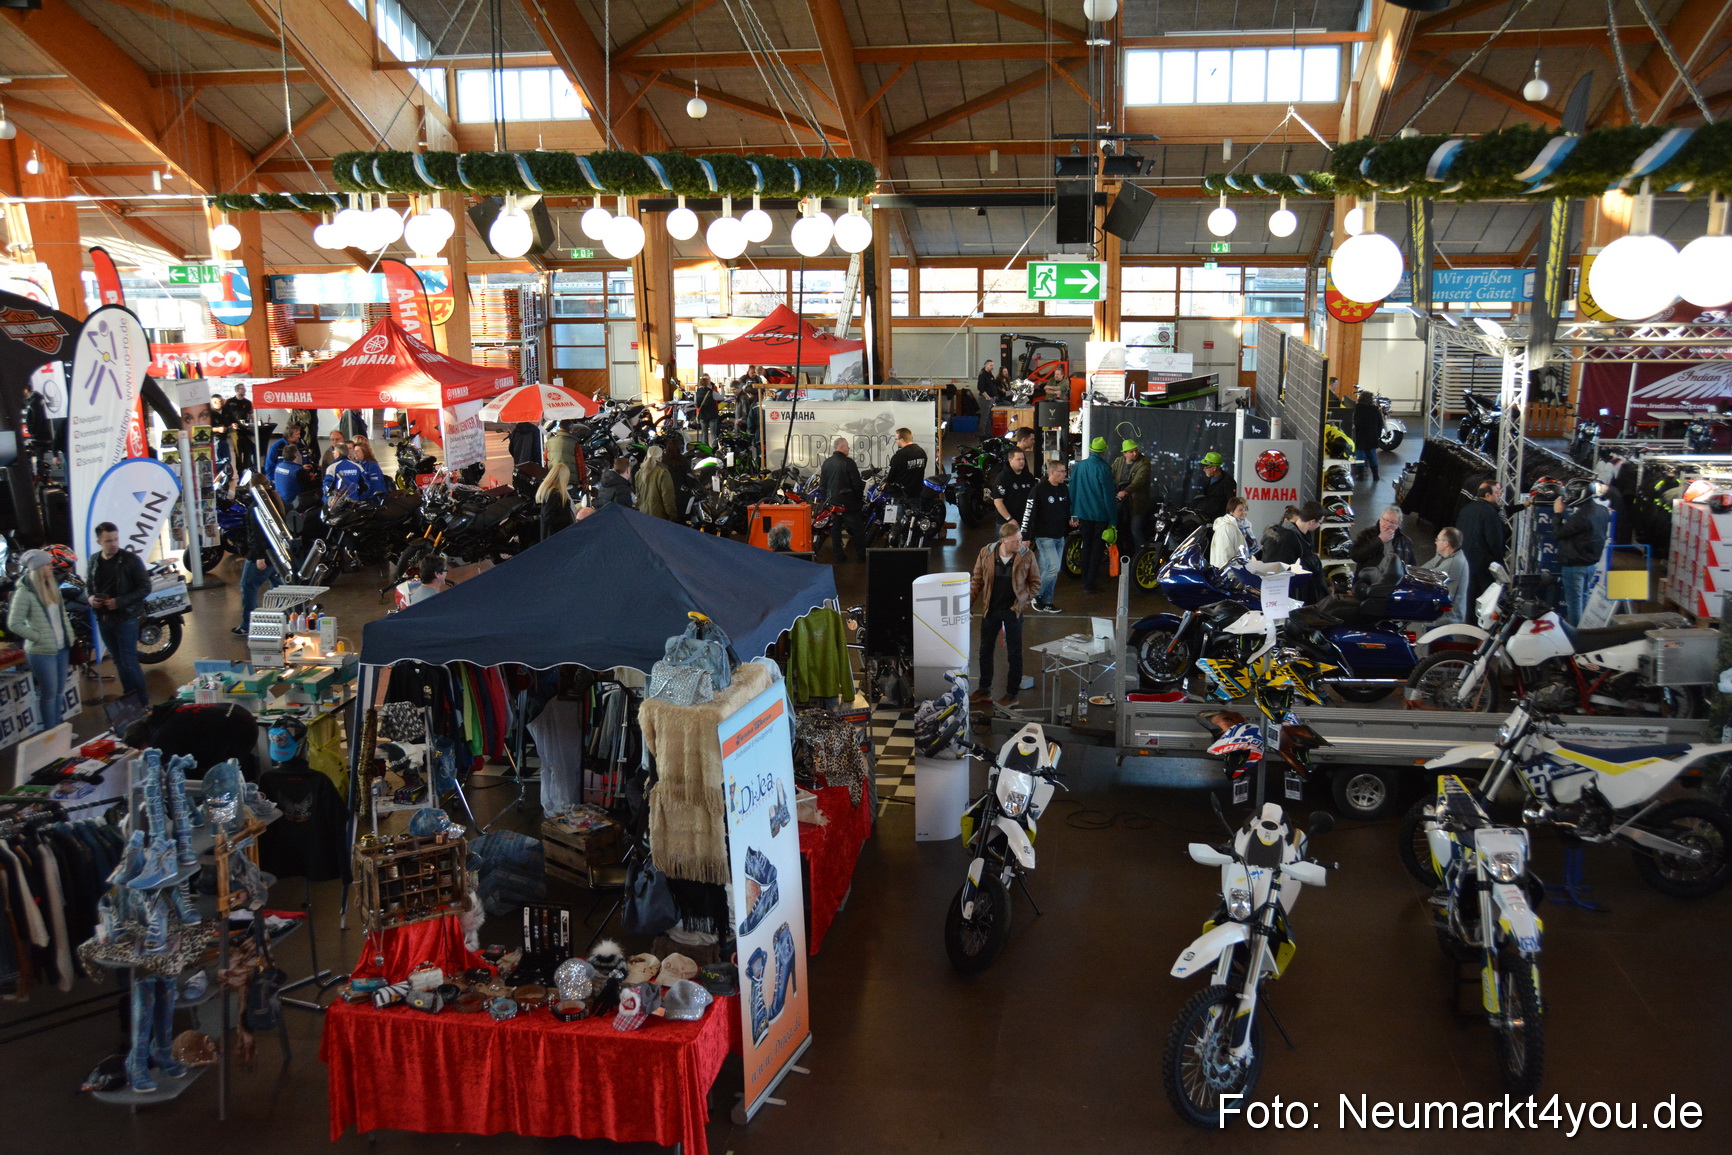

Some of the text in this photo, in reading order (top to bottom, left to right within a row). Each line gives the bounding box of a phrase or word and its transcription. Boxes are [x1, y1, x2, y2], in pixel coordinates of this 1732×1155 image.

[1438, 272, 1463, 285] Wir
[1465, 269, 1512, 290] grüßen
[1432, 289, 1472, 300] unsere
[1476, 286, 1516, 300] Gäste!
[341, 354, 397, 368] YAMAHA
[1677, 370, 1721, 382] Indian
[275, 392, 313, 403] YAMAHA
[781, 411, 815, 421] YAMAHA
[1244, 487, 1298, 501] YAMAHA
[1021, 499, 1034, 533] YAMAHA
